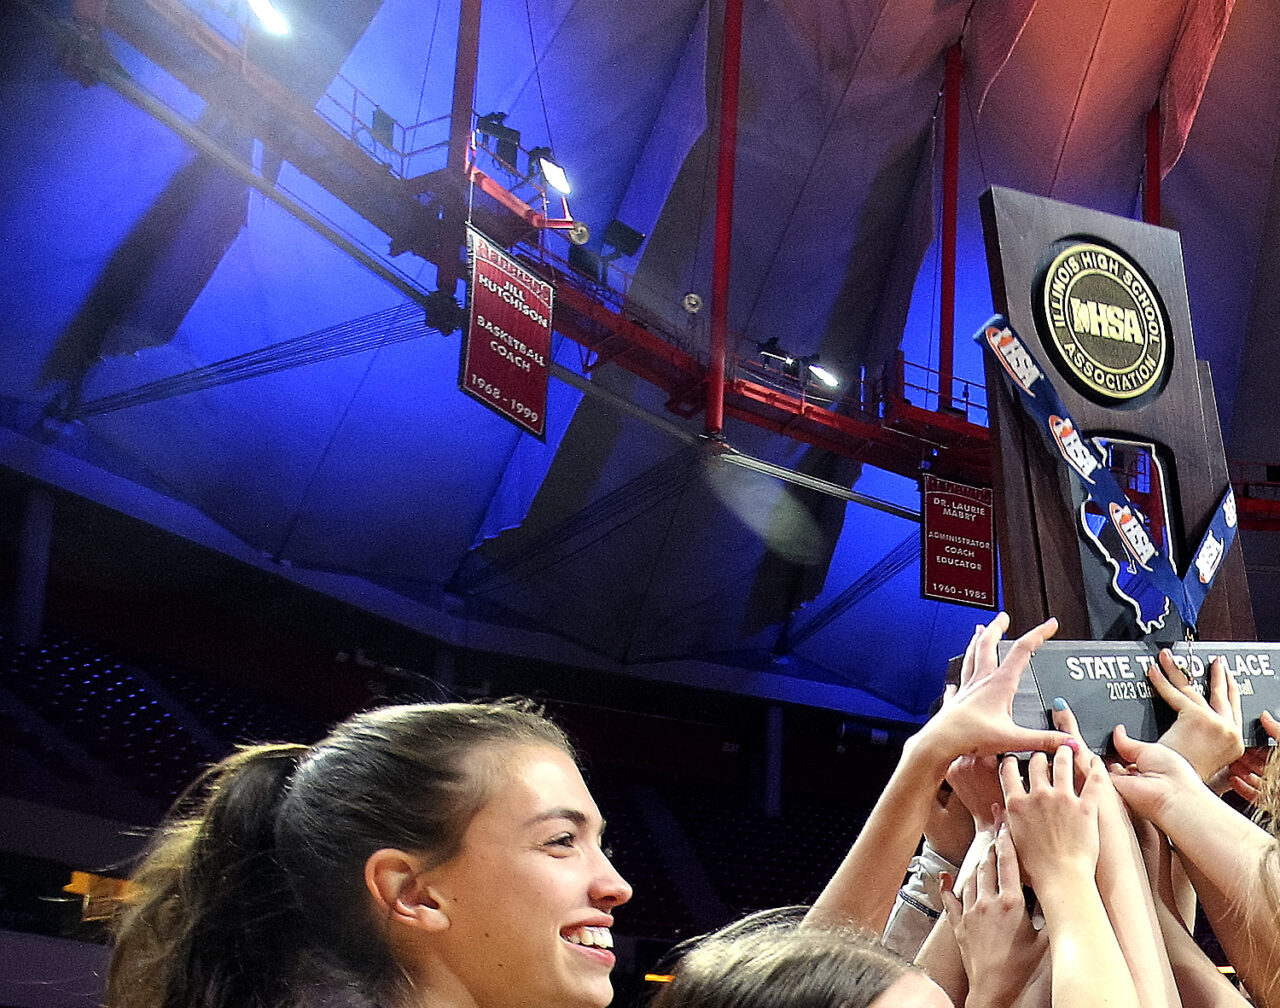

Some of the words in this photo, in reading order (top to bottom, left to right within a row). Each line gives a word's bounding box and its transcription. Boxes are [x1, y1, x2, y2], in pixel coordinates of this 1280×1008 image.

[479, 273, 548, 328] HUTCHISON
[502, 281, 525, 302] JILL
[1051, 254, 1081, 328] ILLINOIS
[1080, 252, 1119, 276] HIGH
[1122, 269, 1160, 345] SCHOOL
[477, 315, 546, 367] BASKETBALL
[490, 340, 531, 372] COACH
[1063, 342, 1157, 391] ASSOCIATION
[472, 374, 501, 399] 1968
[510, 398, 539, 423] 1999
[943, 508, 977, 522] MABRY
[952, 501, 986, 516] LAURIE
[928, 530, 991, 549] ADMINISTRATOR
[944, 545, 975, 558] COACH
[936, 555, 982, 571] EDUCATOR
[932, 583, 956, 594] 1960
[964, 588, 987, 600] 1985
[1065, 656, 1136, 681] STATE
[1106, 681, 1138, 701] 2023
